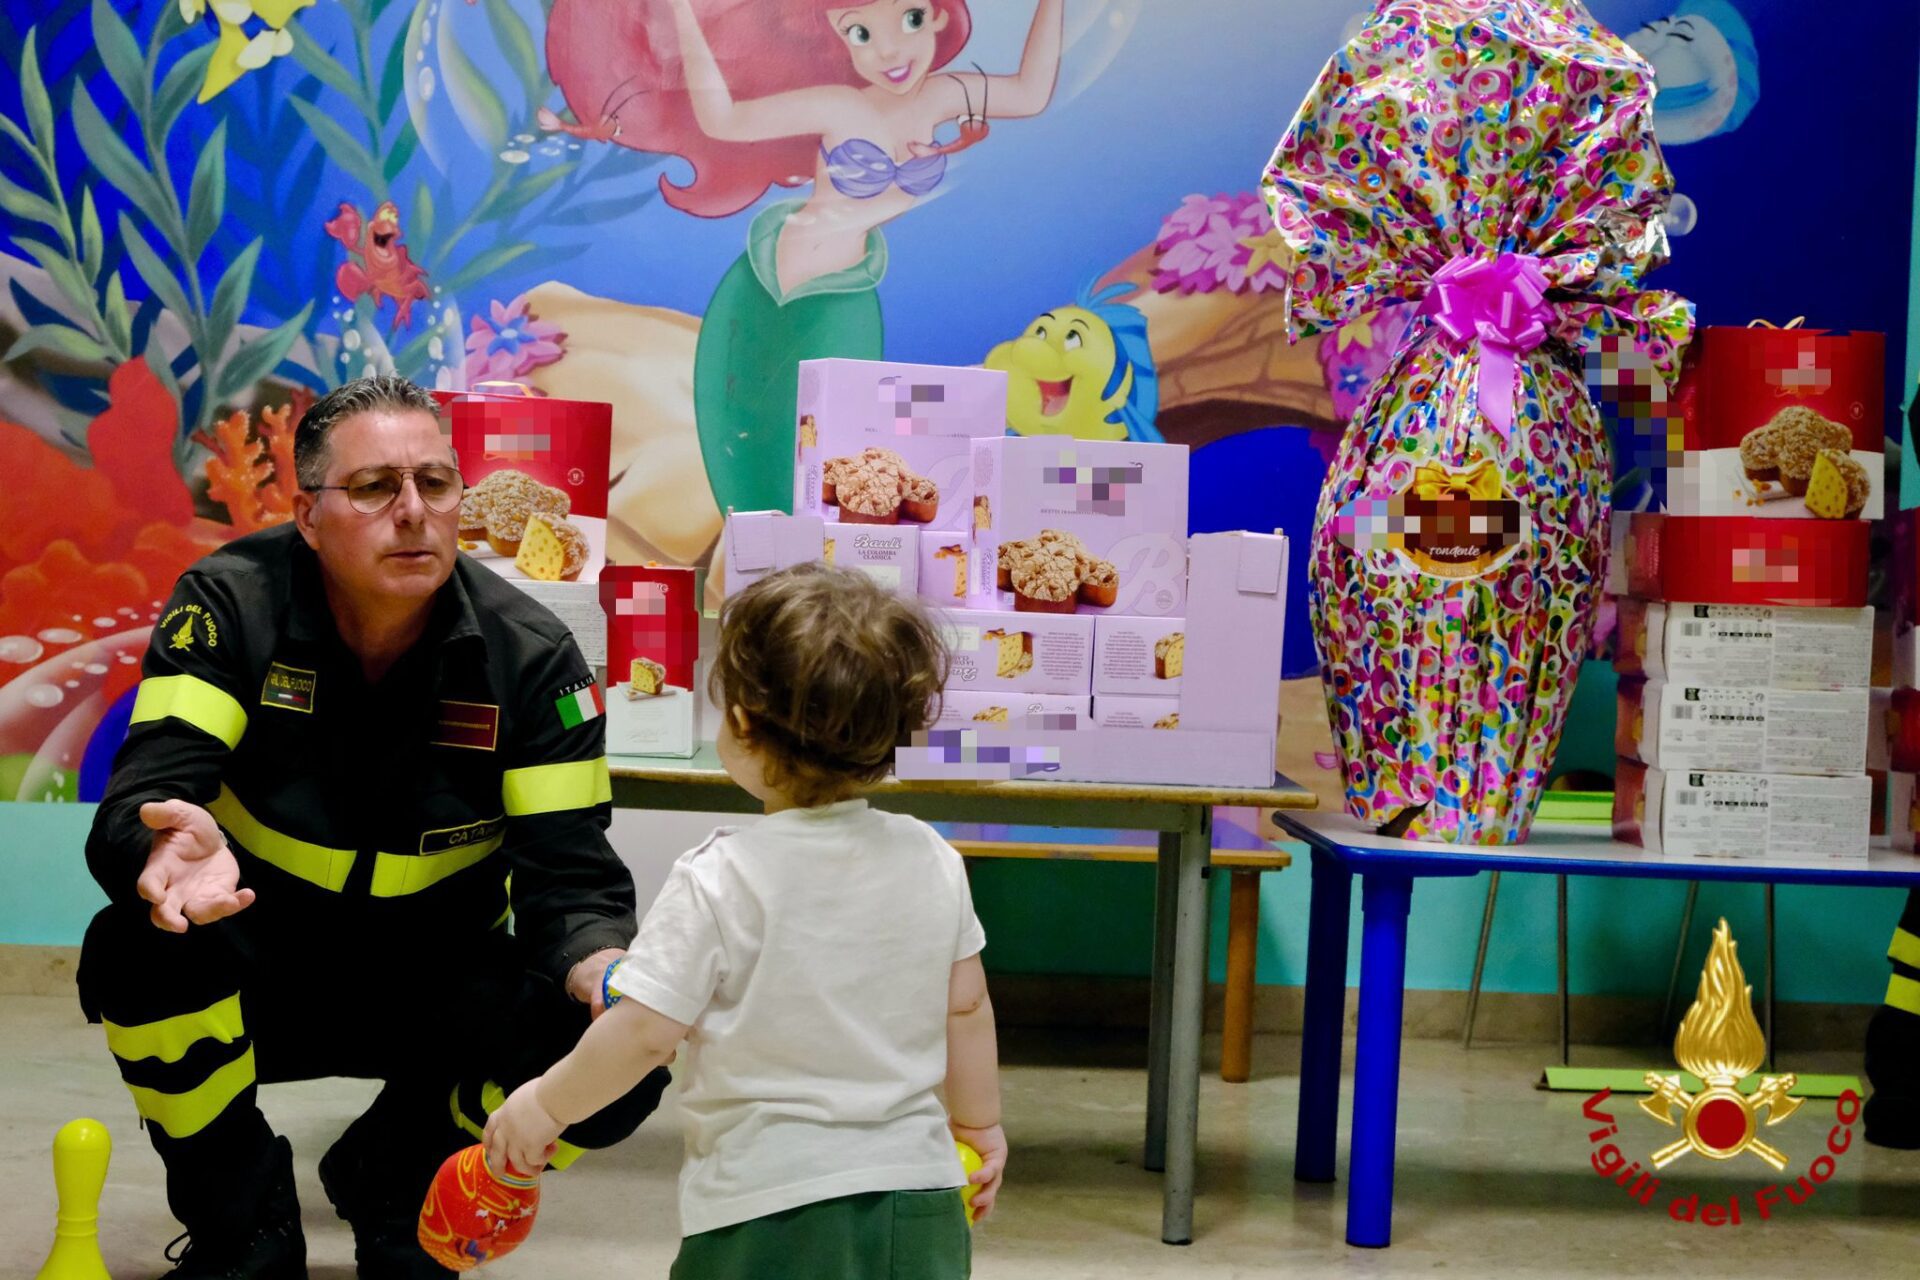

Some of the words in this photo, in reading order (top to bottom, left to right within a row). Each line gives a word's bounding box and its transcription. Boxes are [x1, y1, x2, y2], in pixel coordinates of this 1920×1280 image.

[854, 534, 901, 549] Bauli
[160, 606, 183, 629] VIGILI
[185, 604, 202, 614] DEL
[202, 612, 218, 647] FUOCO
